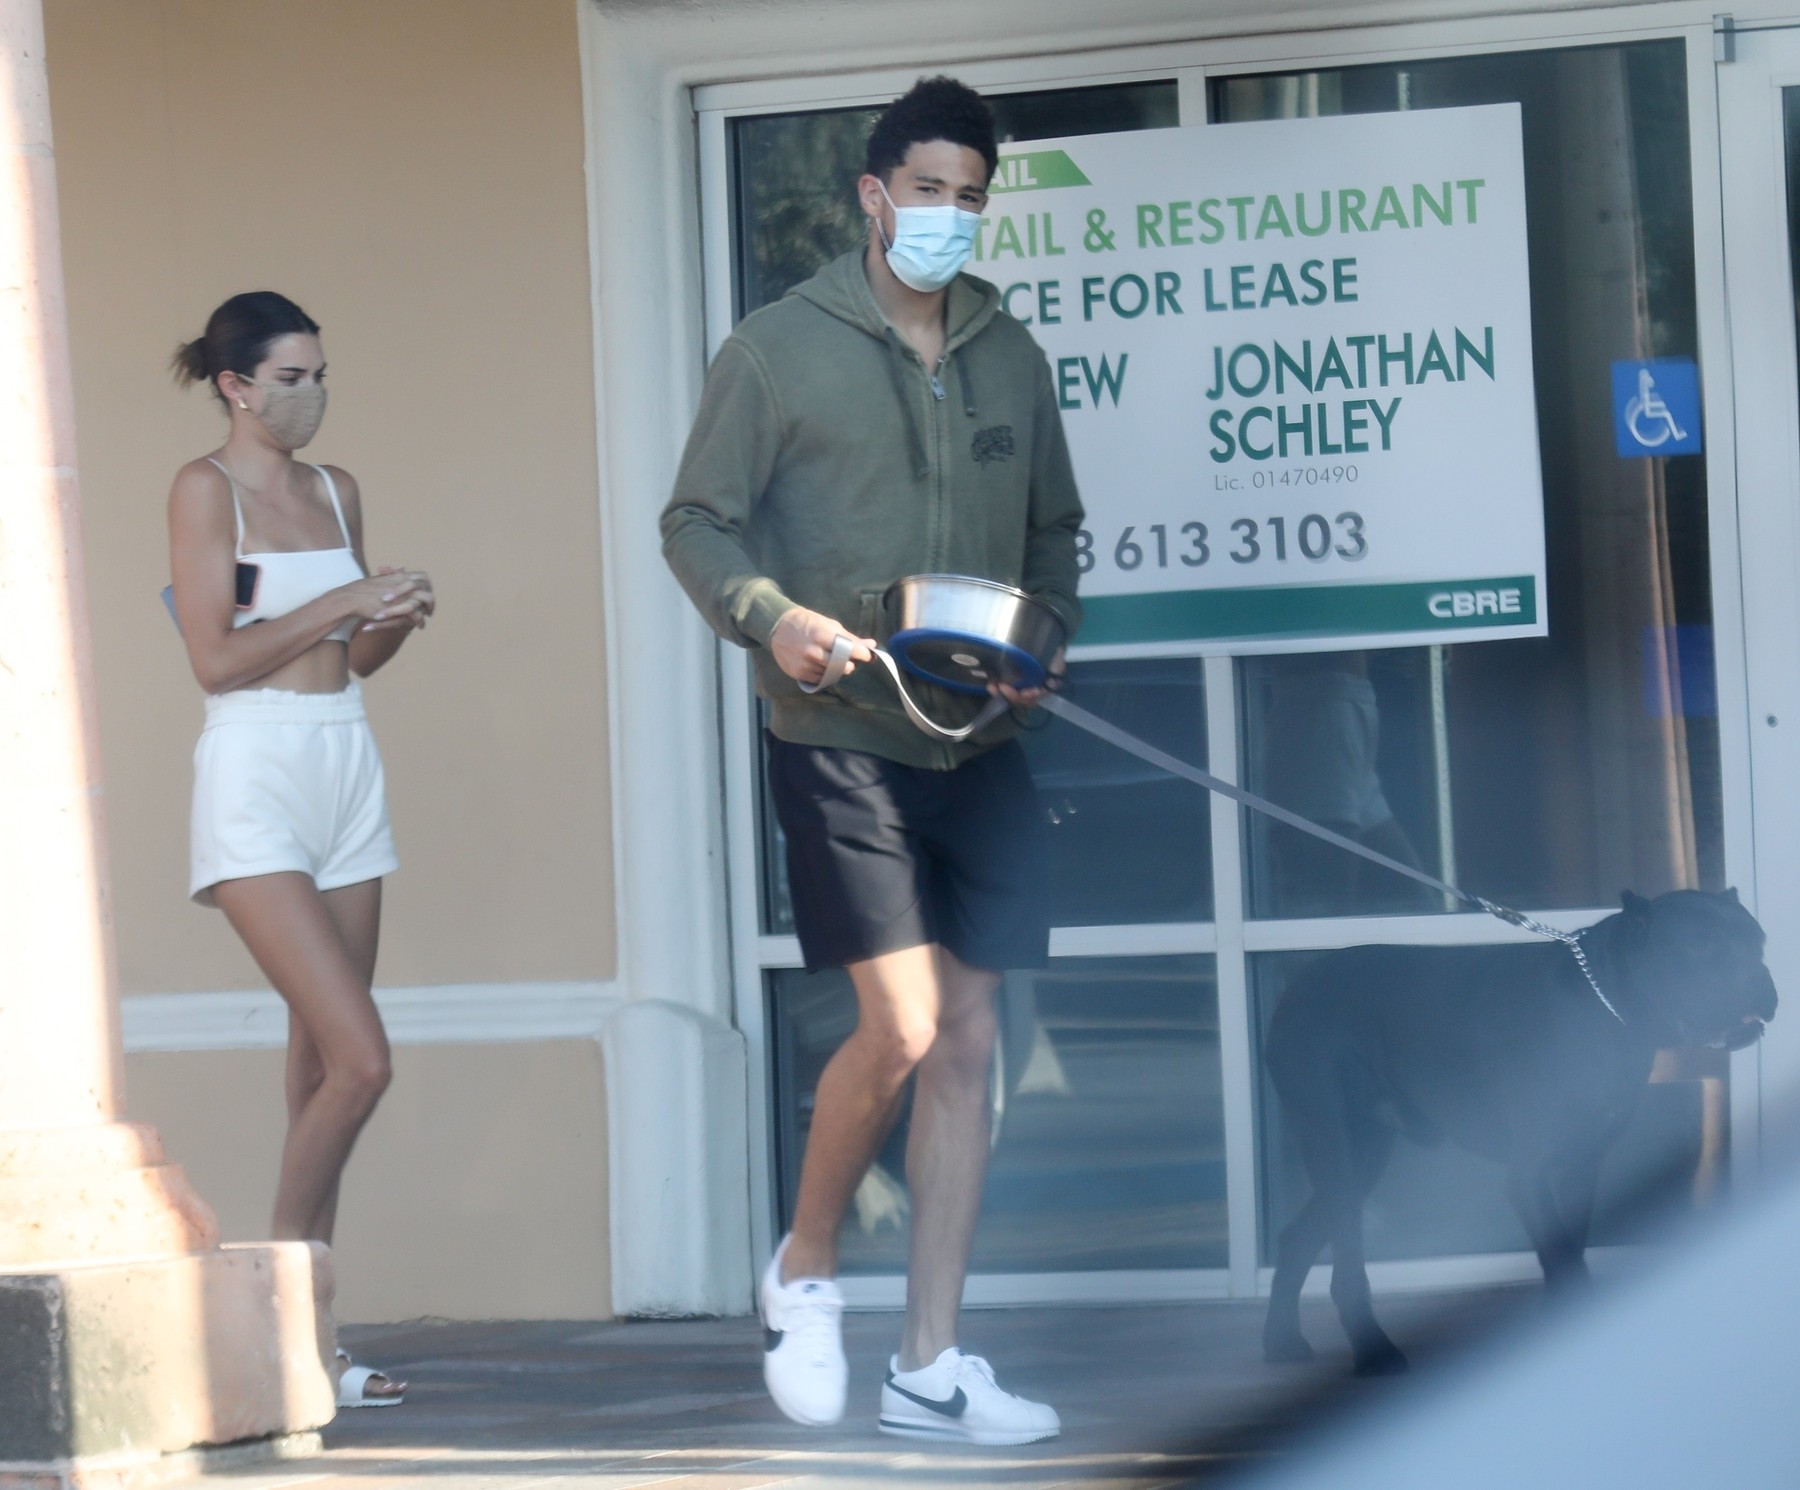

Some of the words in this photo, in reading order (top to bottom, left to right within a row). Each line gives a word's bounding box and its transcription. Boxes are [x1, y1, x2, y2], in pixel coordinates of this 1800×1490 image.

[973, 212, 1066, 261] TAIL
[1083, 208, 1117, 253] &
[1136, 179, 1486, 249] RESTAURANT
[1001, 280, 1062, 327] CE
[1082, 273, 1184, 322] FOR
[1203, 257, 1359, 312] LEASE
[1057, 352, 1129, 410] EW
[1205, 326, 1496, 401] JONATHAN
[1209, 397, 1403, 463] SCHLEY
[1214, 474, 1245, 491] Lic.
[1252, 464, 1359, 489] 01470490
[1114, 522, 1211, 571] 613
[1229, 511, 1369, 563] 3103
[1428, 587, 1521, 618] CBRE
